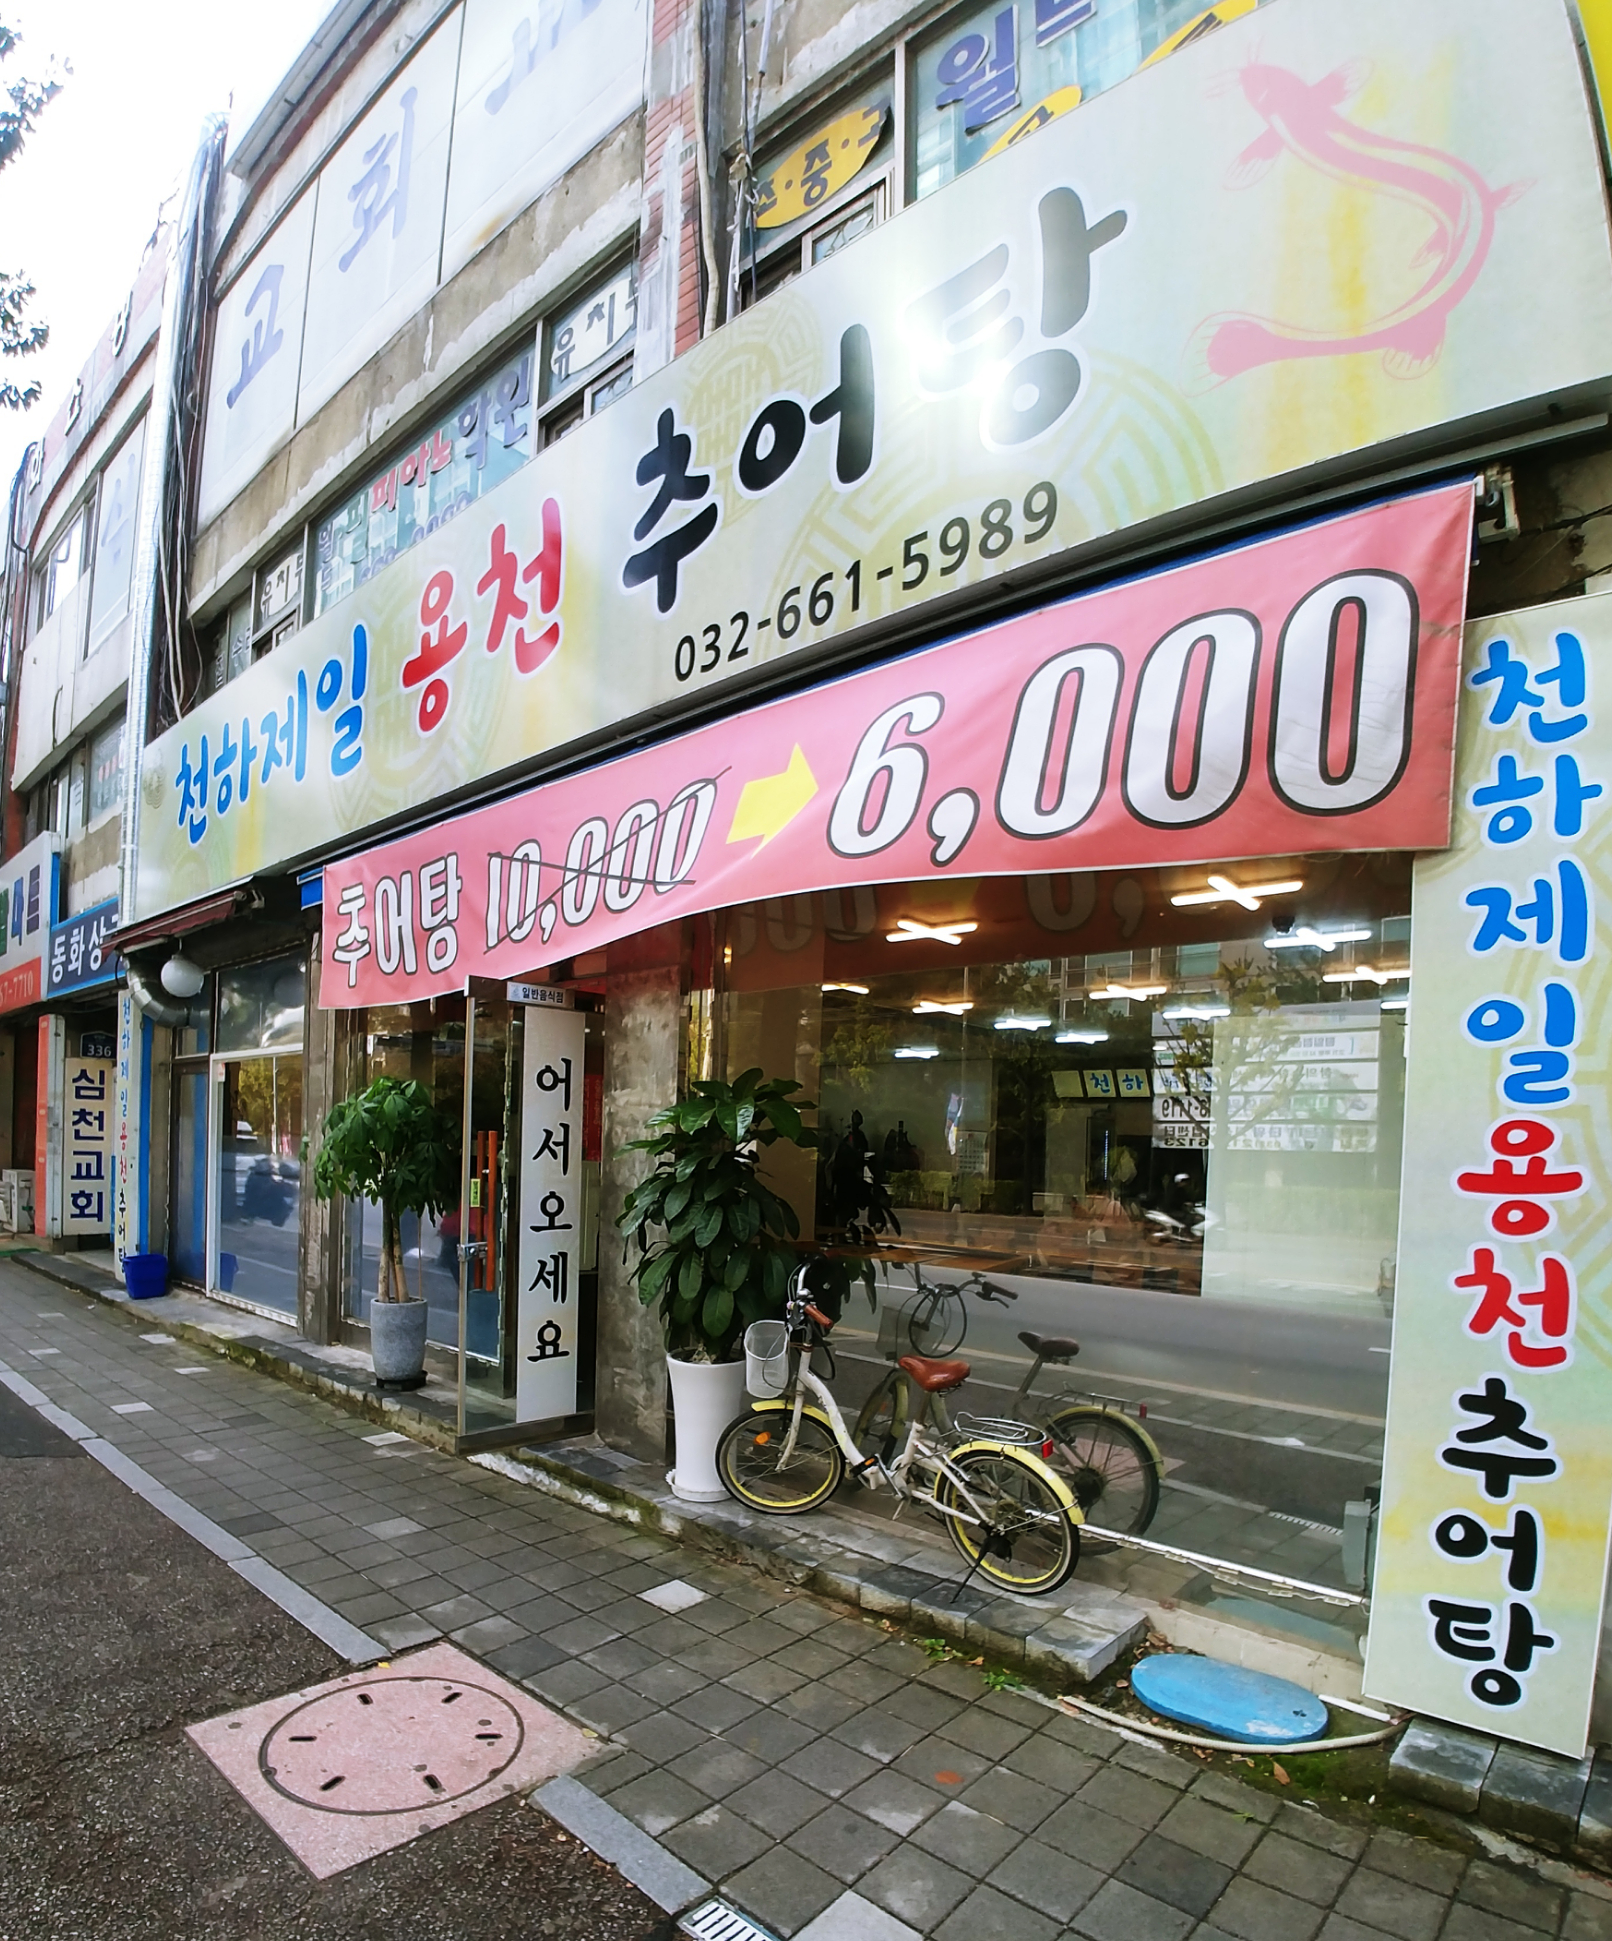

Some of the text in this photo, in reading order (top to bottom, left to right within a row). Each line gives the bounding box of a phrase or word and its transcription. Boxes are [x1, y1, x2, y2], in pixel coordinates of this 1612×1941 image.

[371, 428, 452, 514] 피아노
[458, 357, 531, 471] 학원
[174, 623, 368, 845] 천하제일
[402, 497, 563, 733] 용천
[621, 186, 1127, 613] 추어탕
[674, 480, 1060, 682] 032-661-5989
[332, 851, 462, 988] 추어탕
[485, 777, 718, 952] 10,000
[827, 567, 1422, 868] 6,000
[52, 904, 119, 984] 동화상
[522, 986, 564, 1004] 일반음식점
[87, 1044, 112, 1058] 336
[120, 997, 132, 1118] 천하제일
[70, 1068, 105, 1223] 심천교회
[119, 1121, 129, 1184] 용천
[1428, 630, 1603, 1706] 천하제일 용천 추어탕
